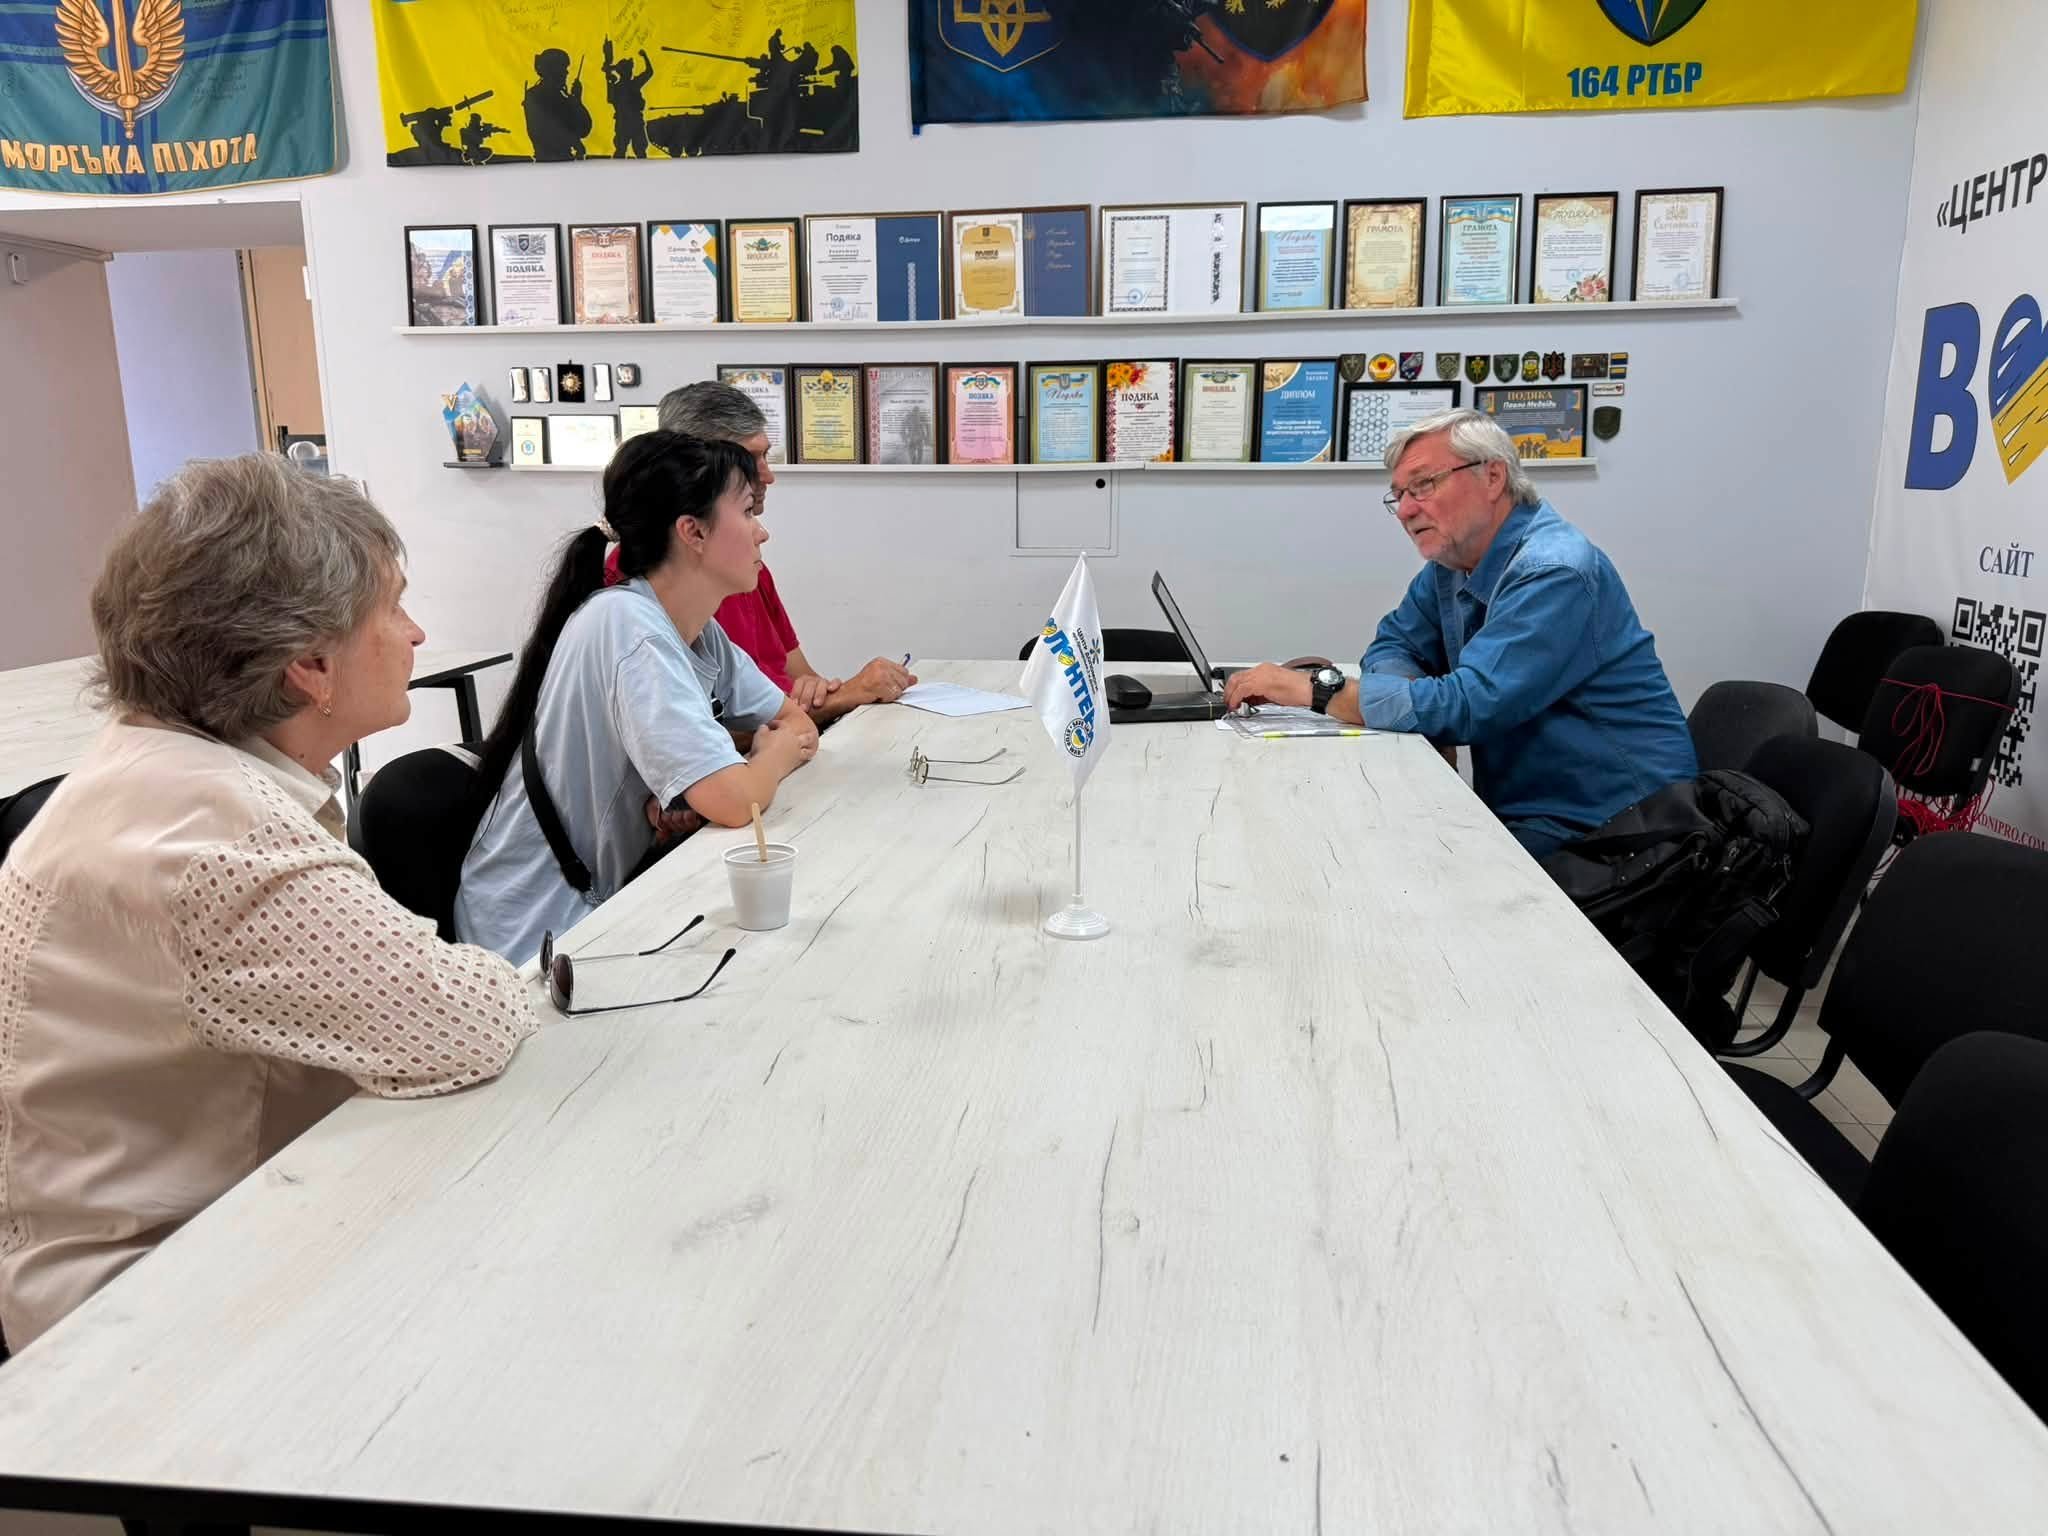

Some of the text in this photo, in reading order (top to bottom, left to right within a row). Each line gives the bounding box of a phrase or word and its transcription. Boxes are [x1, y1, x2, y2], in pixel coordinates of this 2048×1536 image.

[1566, 62, 1703, 98] 164 РТБР
[0, 132, 258, 175] МОРСЬКА ПІХОТА
[1936, 152, 2048, 234] «ЦЕНТР
[1366, 224, 1404, 233] ГРАМОТА
[1462, 224, 1498, 232] ГРАМОТА
[825, 232, 862, 242] Подяка
[506, 265, 545, 273] ПОДЯКА
[1121, 391, 1160, 402] ПОДЯКА
[1279, 389, 1316, 400] ДИПЛОМ
[1507, 391, 1553, 401] ПОДЯКА
[1979, 542, 2035, 578] САЙТ
